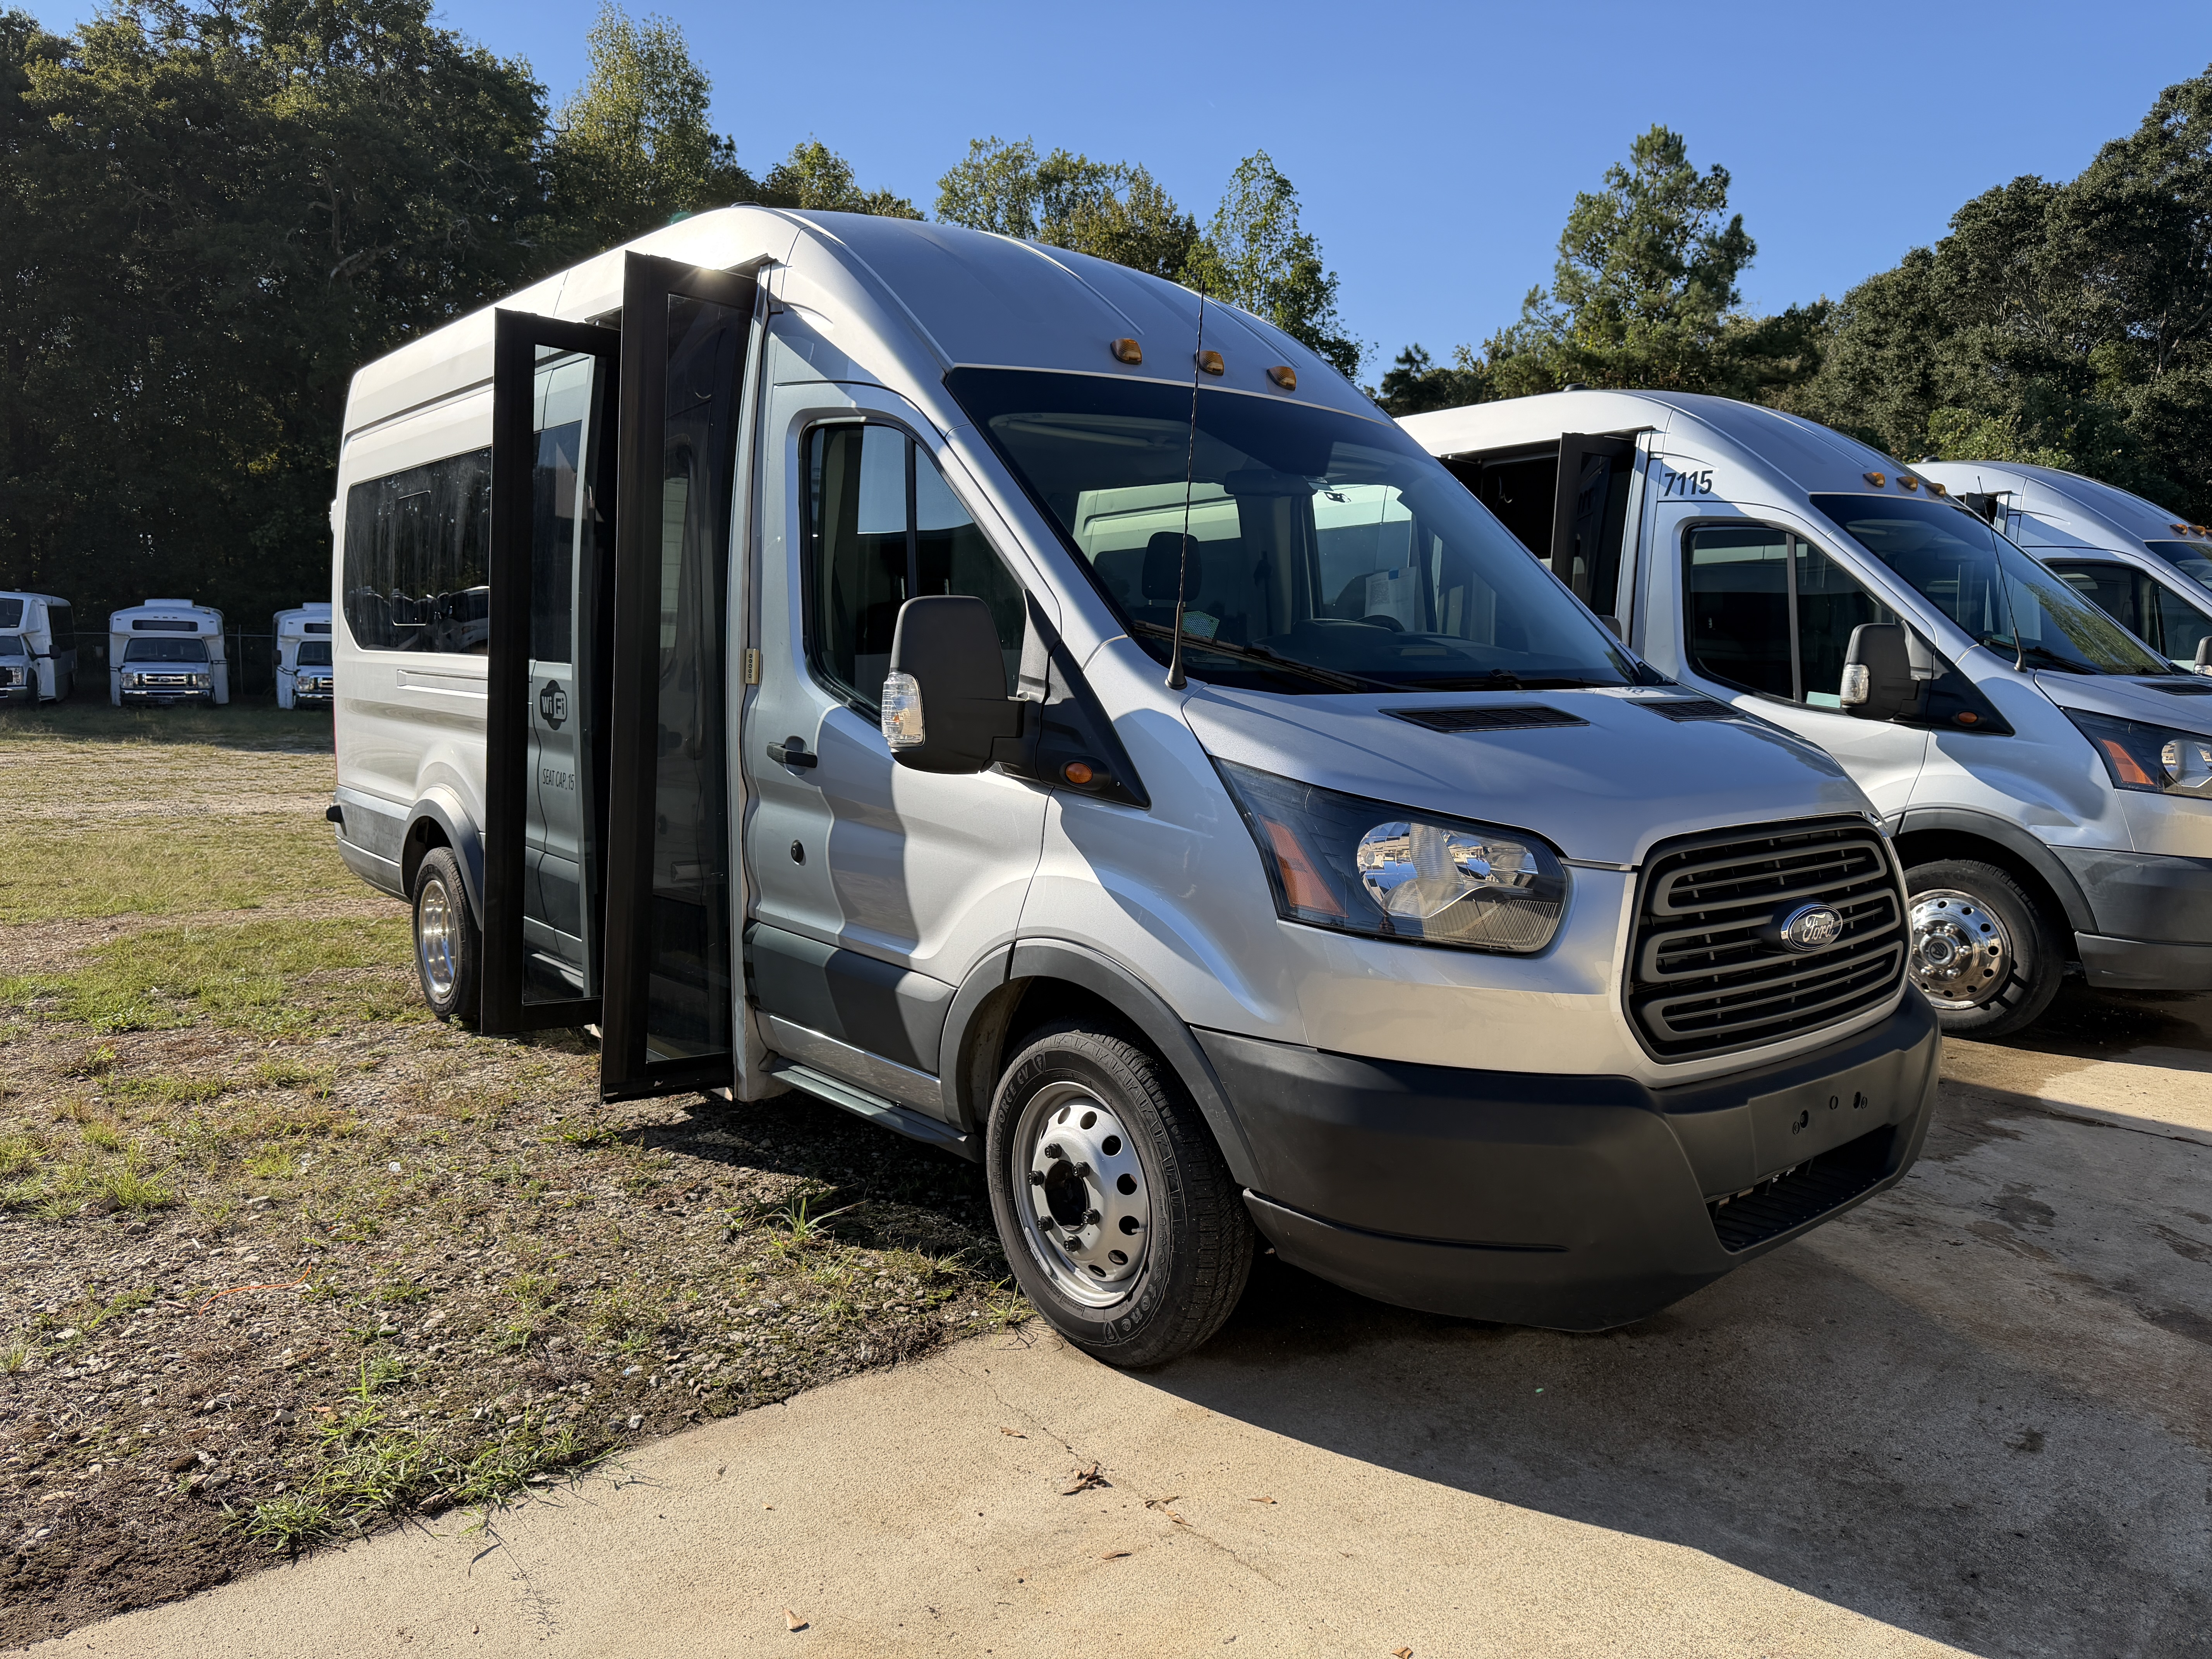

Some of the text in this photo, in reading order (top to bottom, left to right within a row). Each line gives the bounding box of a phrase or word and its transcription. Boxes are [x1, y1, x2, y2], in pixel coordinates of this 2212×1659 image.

[1663, 470, 1714, 497] 7115
[543, 768, 575, 790] SEAT CAP. 15
[1802, 913, 1835, 943] Ford
[992, 1064, 1029, 1193] TRANSFORCE CV
[1120, 1194, 1167, 1331] Firestone
